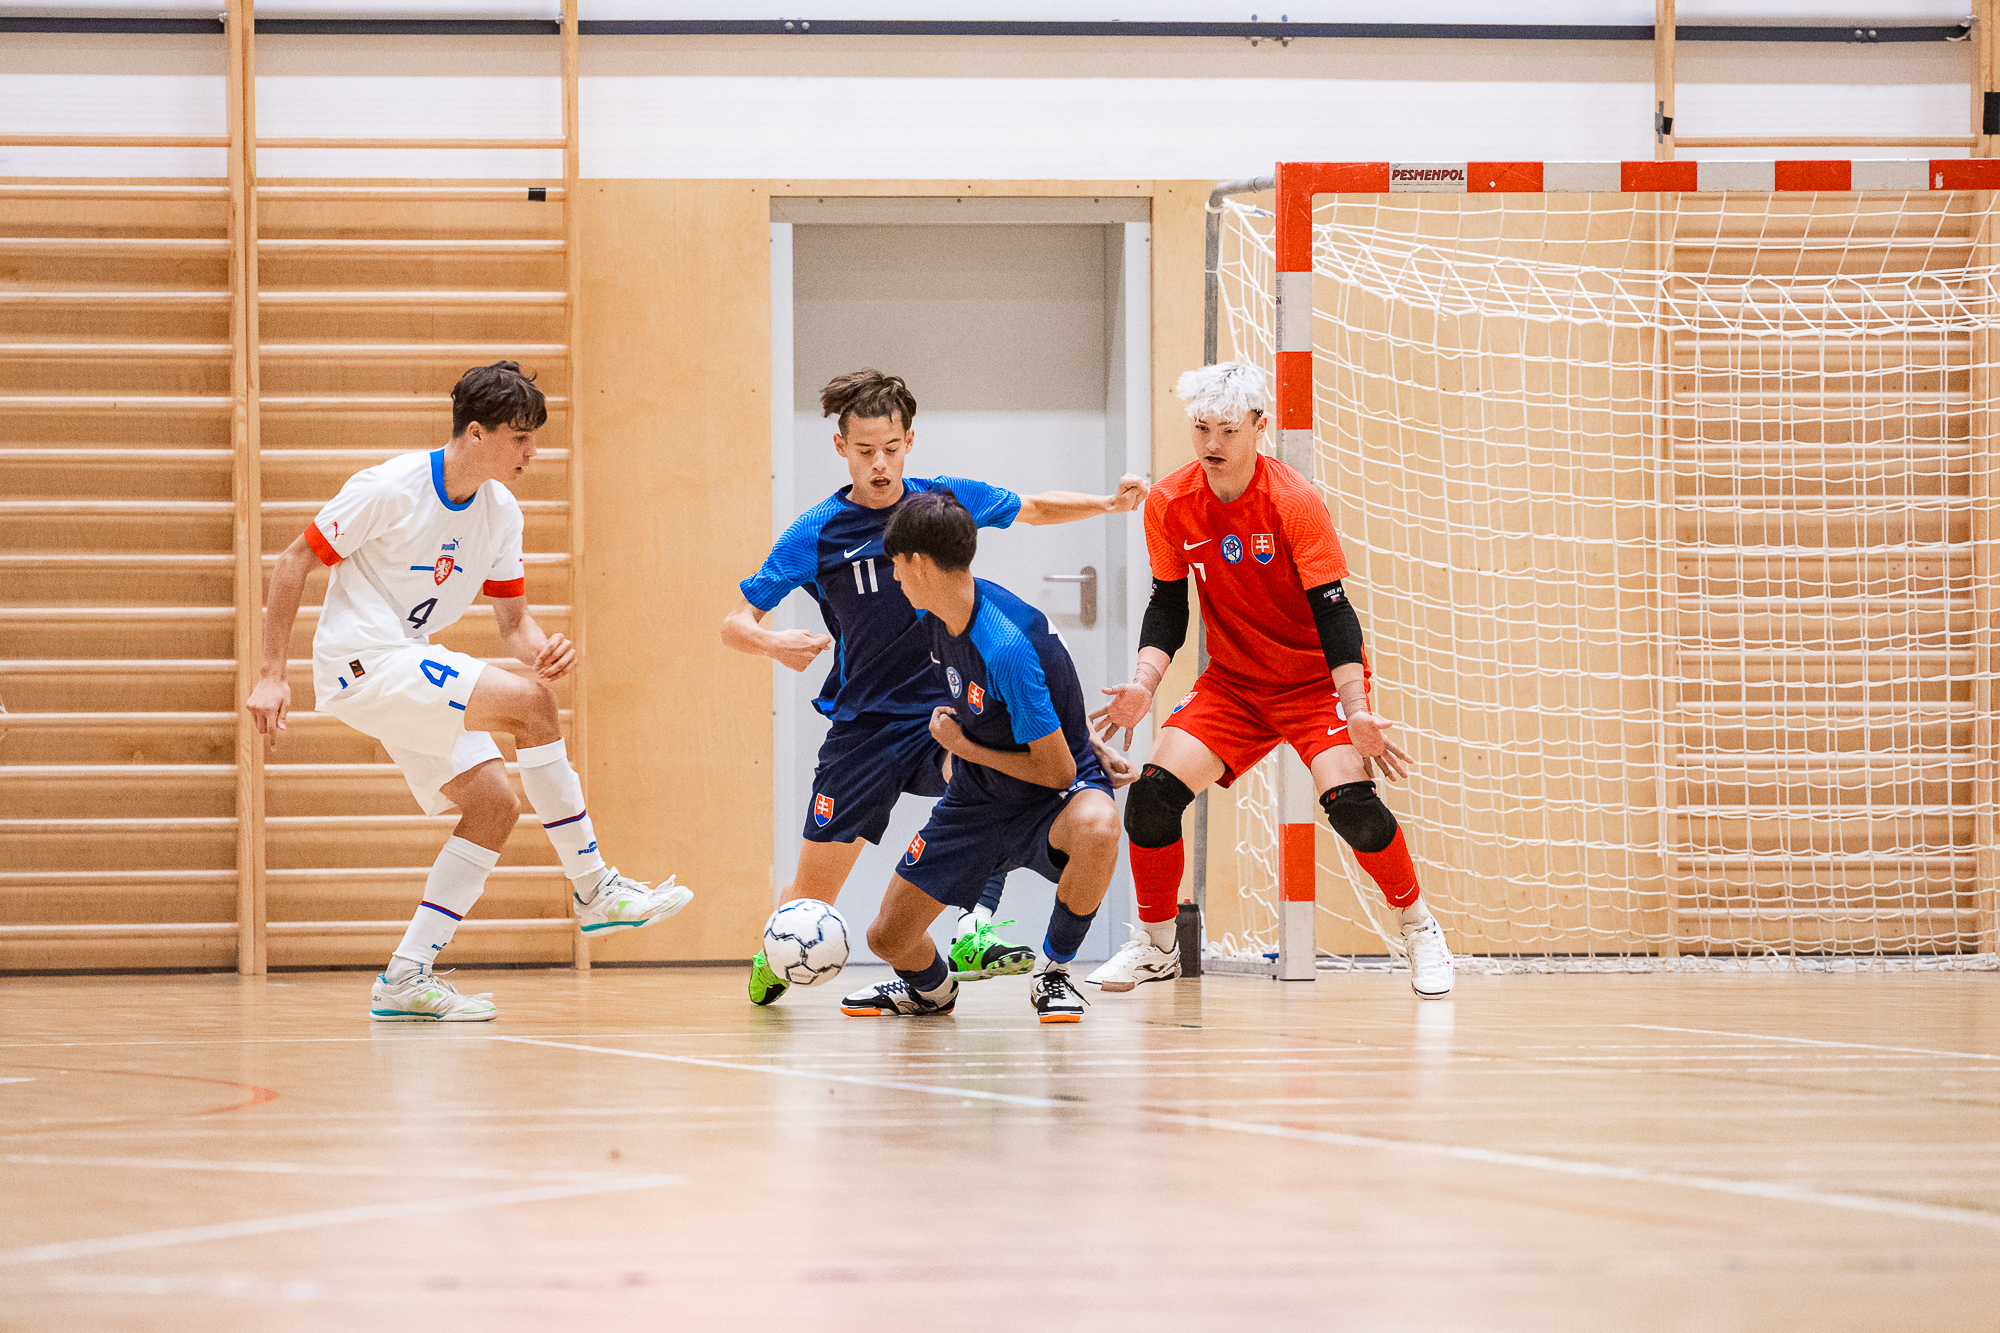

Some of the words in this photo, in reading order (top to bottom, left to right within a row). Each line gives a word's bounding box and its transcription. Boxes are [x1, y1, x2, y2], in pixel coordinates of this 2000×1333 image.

[1391, 169, 1465, 181] PESMENPOL
[851, 558, 879, 595] 11
[406, 597, 438, 629] 4
[419, 659, 460, 688] 4
